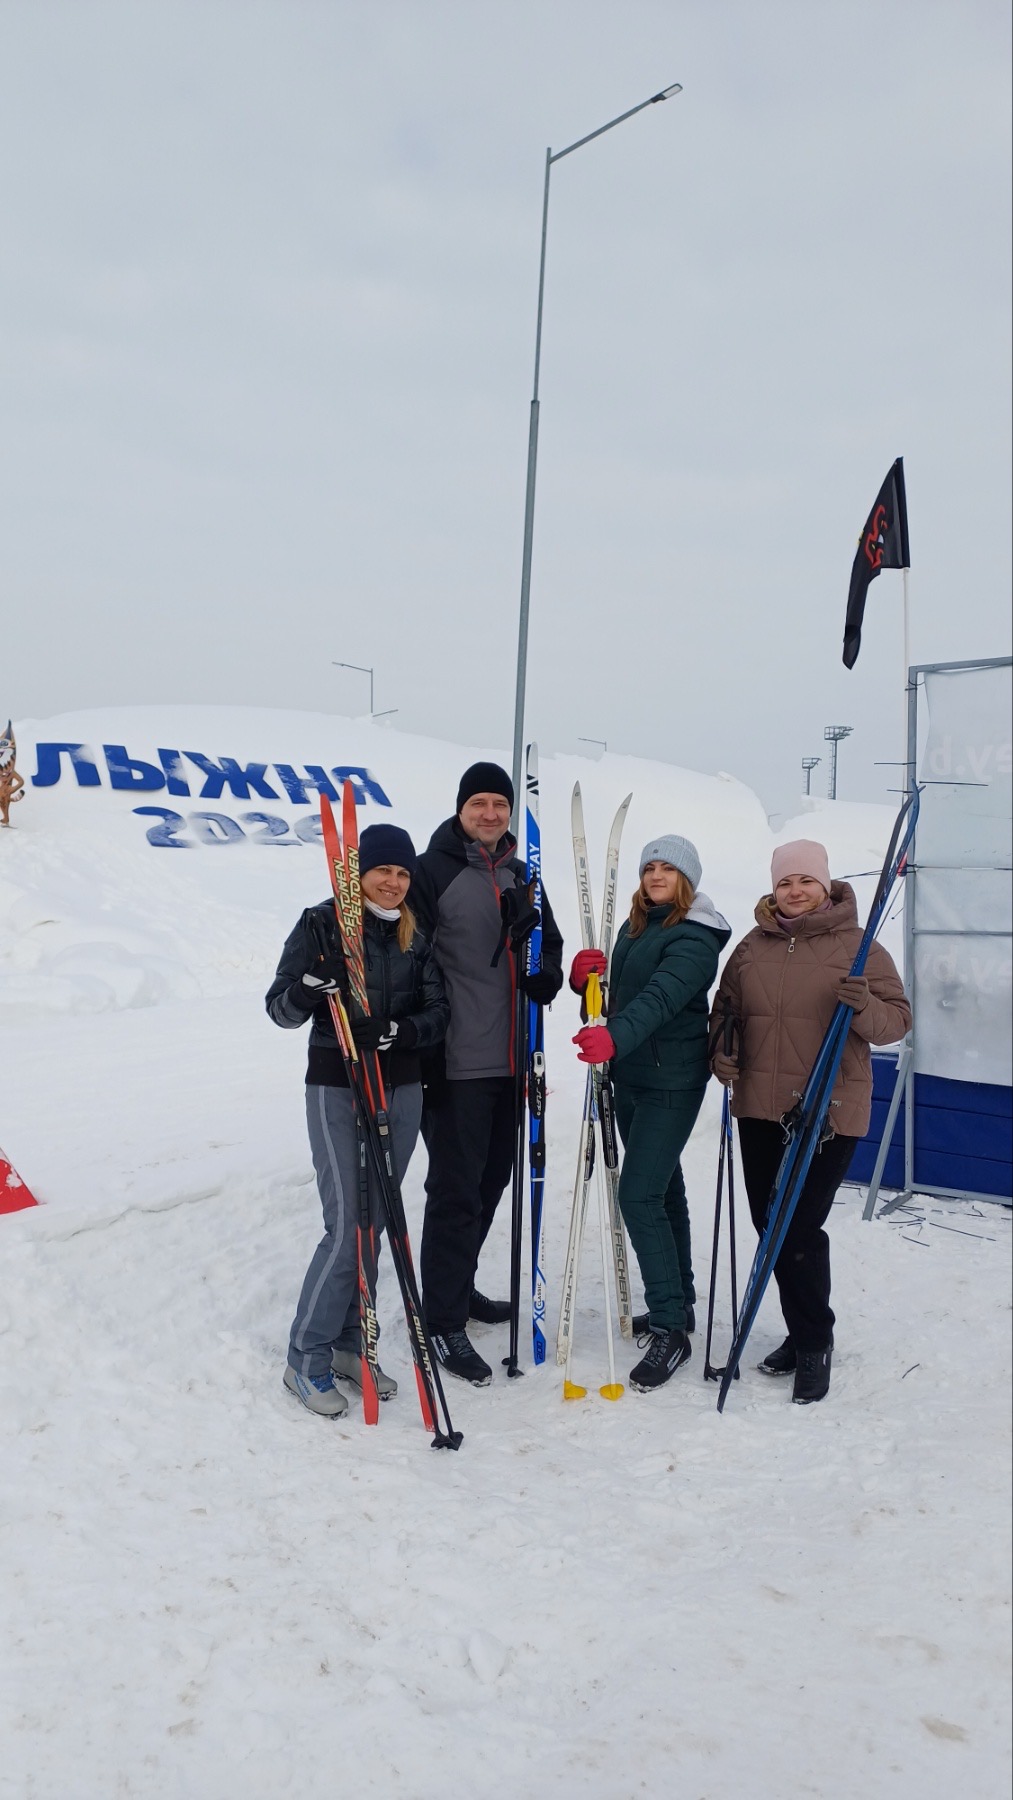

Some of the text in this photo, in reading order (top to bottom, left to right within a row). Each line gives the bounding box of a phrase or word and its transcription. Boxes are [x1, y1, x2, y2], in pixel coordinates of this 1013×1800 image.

[31, 742, 393, 808] ЛЫЖНЯ
[332, 858, 357, 937] PELTONEN
[346, 845, 362, 926] PELTONEN
[532, 952, 542, 970] XC
[614, 1232, 628, 1302] FISCHER
[365, 1307, 378, 1366] ULTIMA
[533, 1299, 545, 1322] XC
